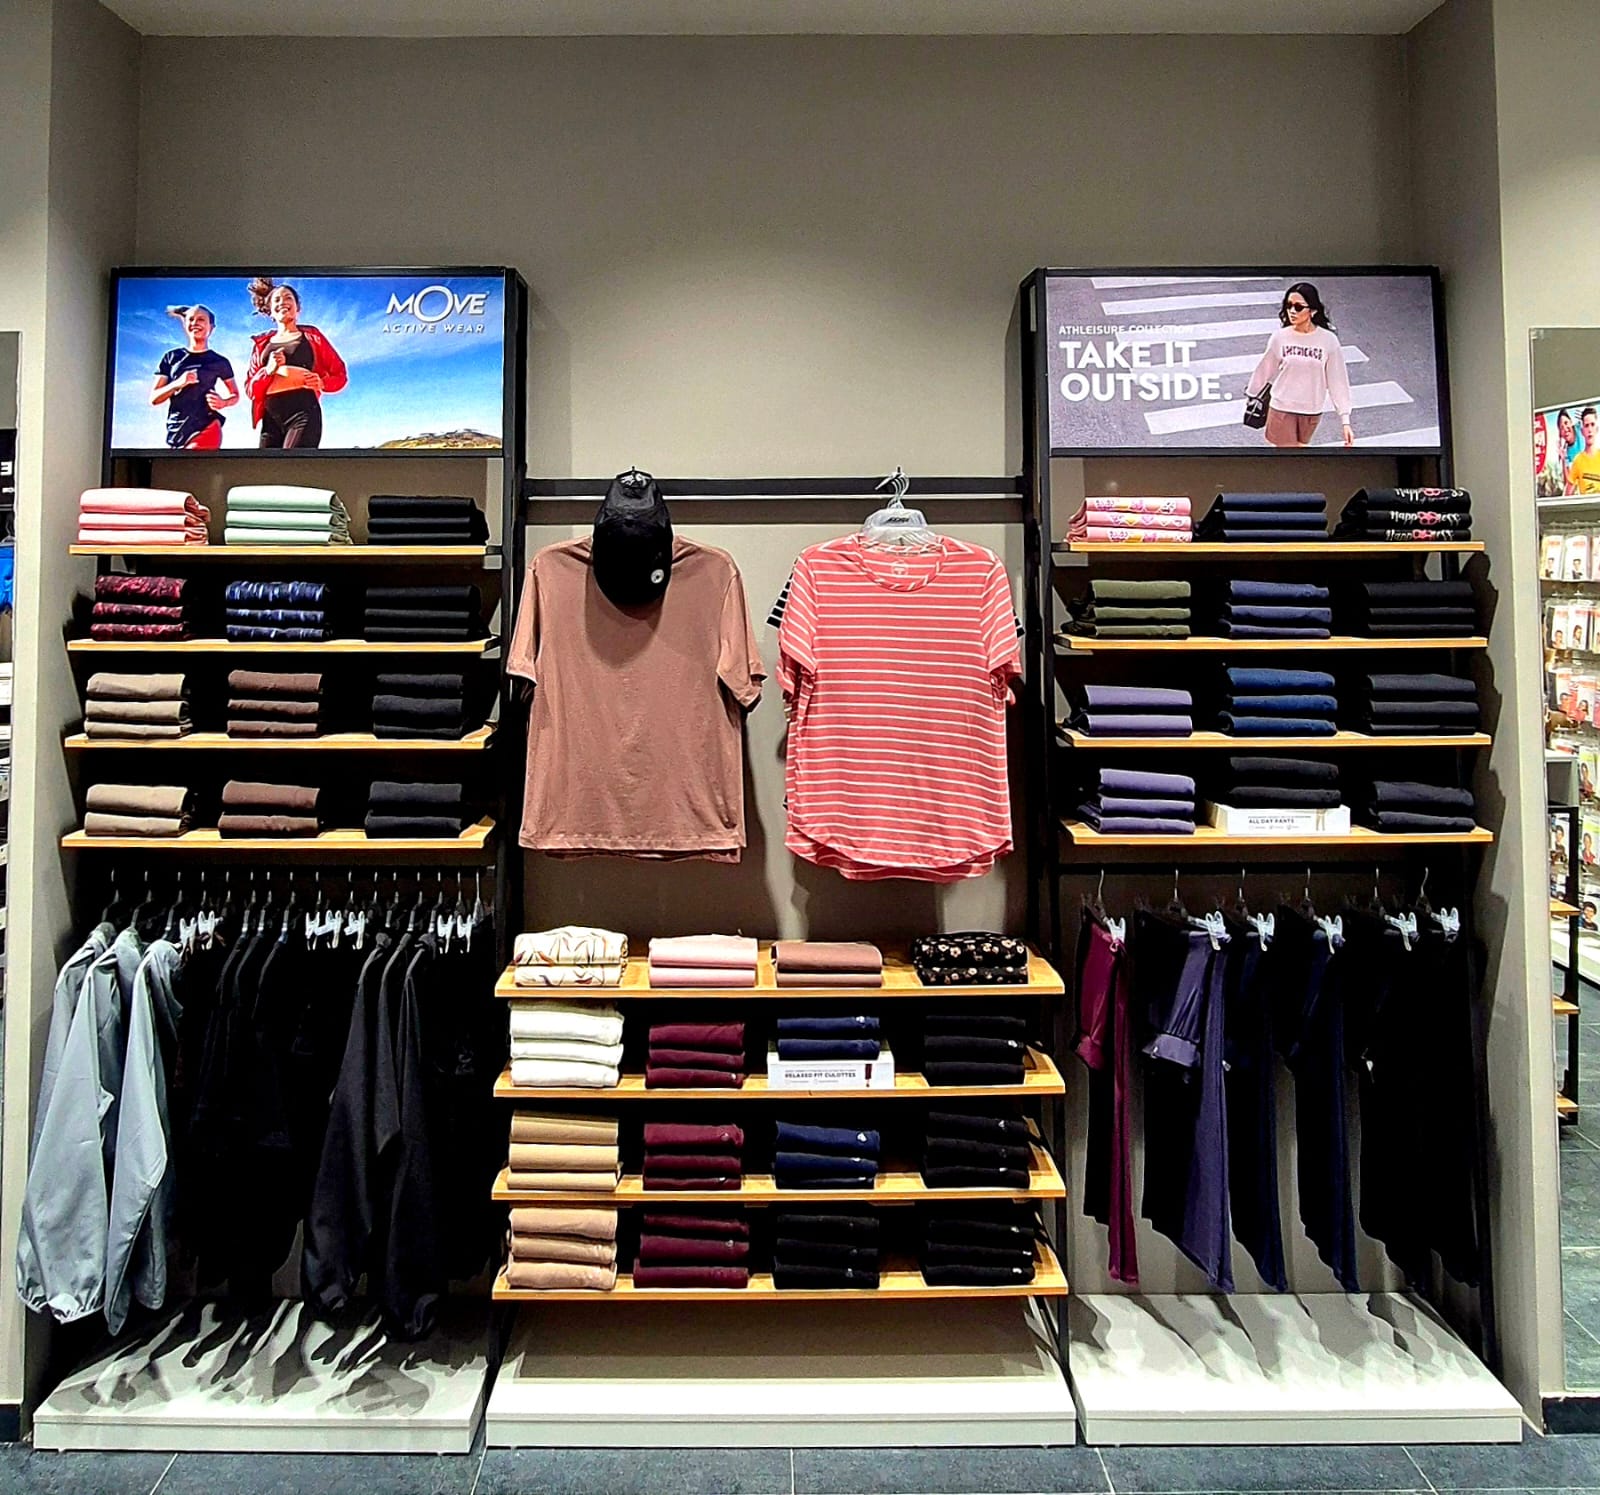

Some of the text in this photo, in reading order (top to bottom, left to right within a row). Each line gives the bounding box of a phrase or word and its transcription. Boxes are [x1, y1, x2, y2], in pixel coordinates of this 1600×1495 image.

[385, 285, 487, 323] MOVE
[382, 323, 485, 334] ACTIVE WEAR
[1058, 324, 1126, 335] ATHLEISURE
[1059, 340, 1197, 369] TAKE IT
[1060, 372, 1233, 401] OUTSIDE.
